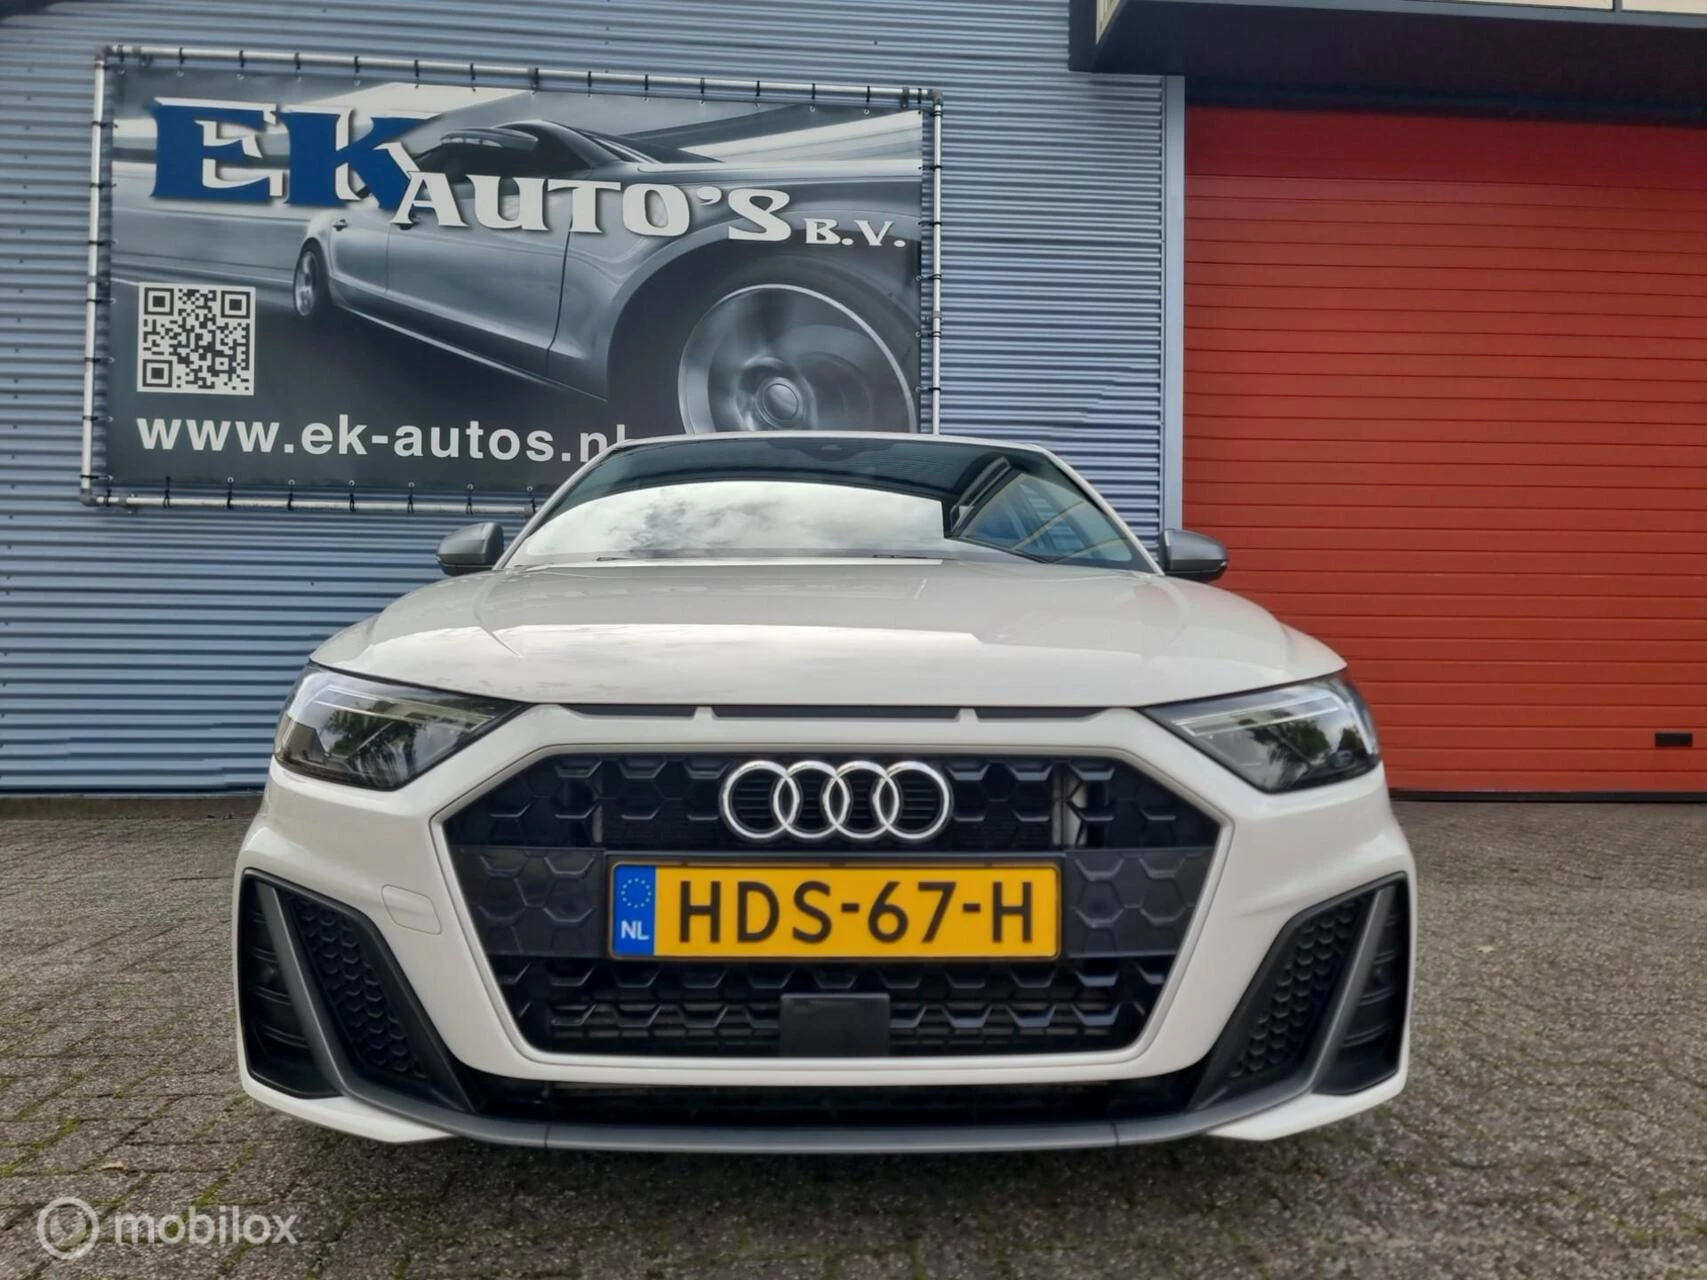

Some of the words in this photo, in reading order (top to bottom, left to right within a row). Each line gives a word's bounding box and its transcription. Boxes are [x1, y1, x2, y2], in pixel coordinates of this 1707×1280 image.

[150, 97, 438, 211] EK
[804, 217, 906, 247] B.V.
[620, 919, 650, 941] NL
[679, 880, 1033, 945] HDS-67-H
